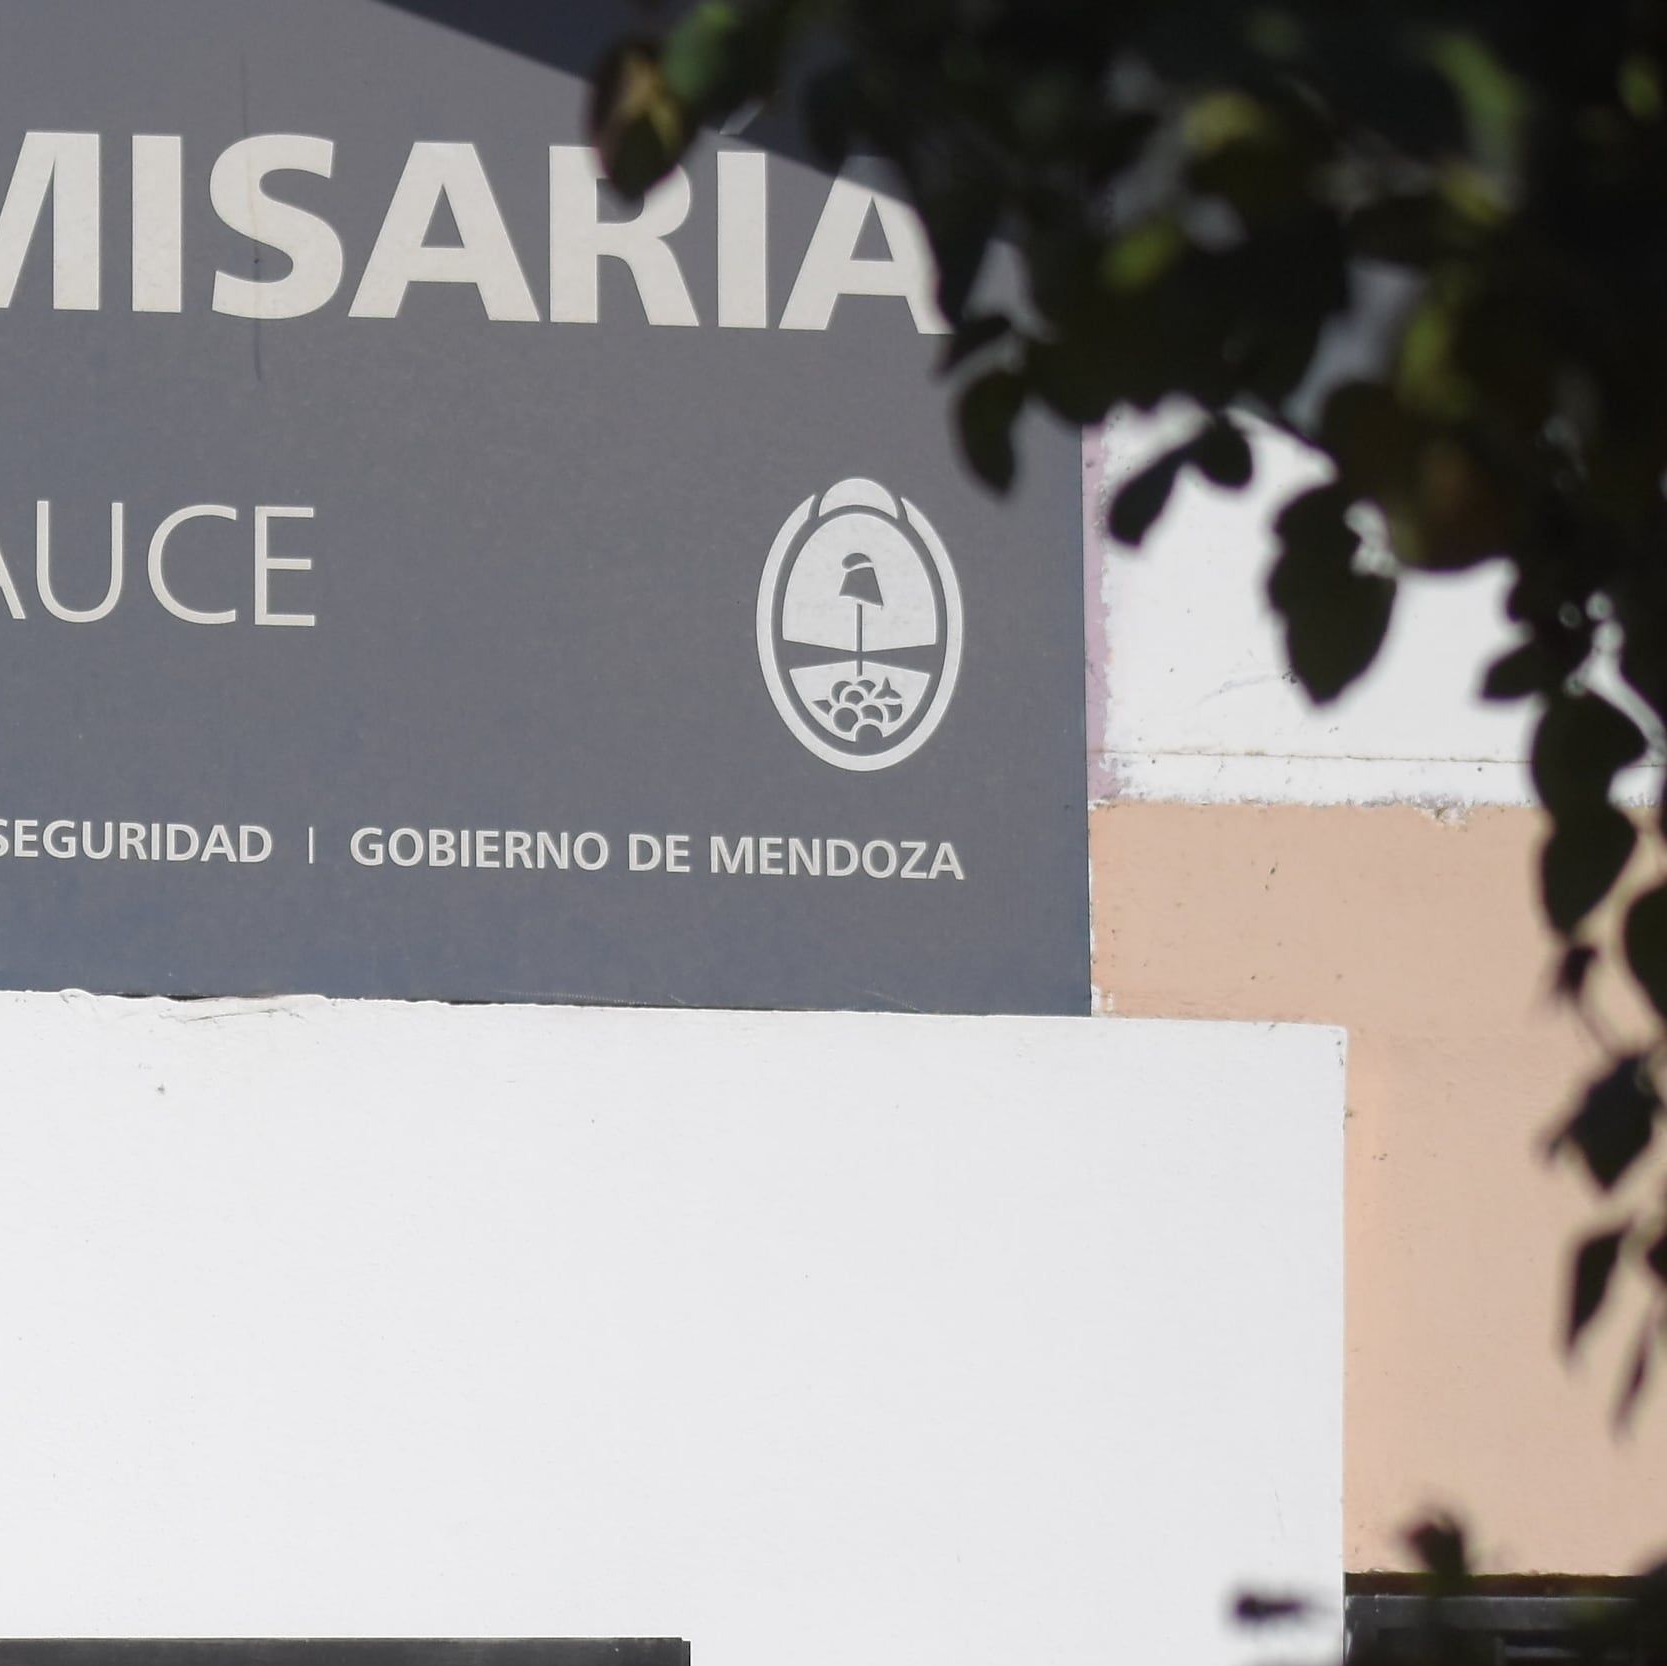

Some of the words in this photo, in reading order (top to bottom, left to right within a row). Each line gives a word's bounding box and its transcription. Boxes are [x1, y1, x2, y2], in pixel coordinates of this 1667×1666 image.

[349, 826, 610, 871] GOBIERNO
[628, 833, 690, 873] DE
[709, 836, 965, 880] MENDOZA
